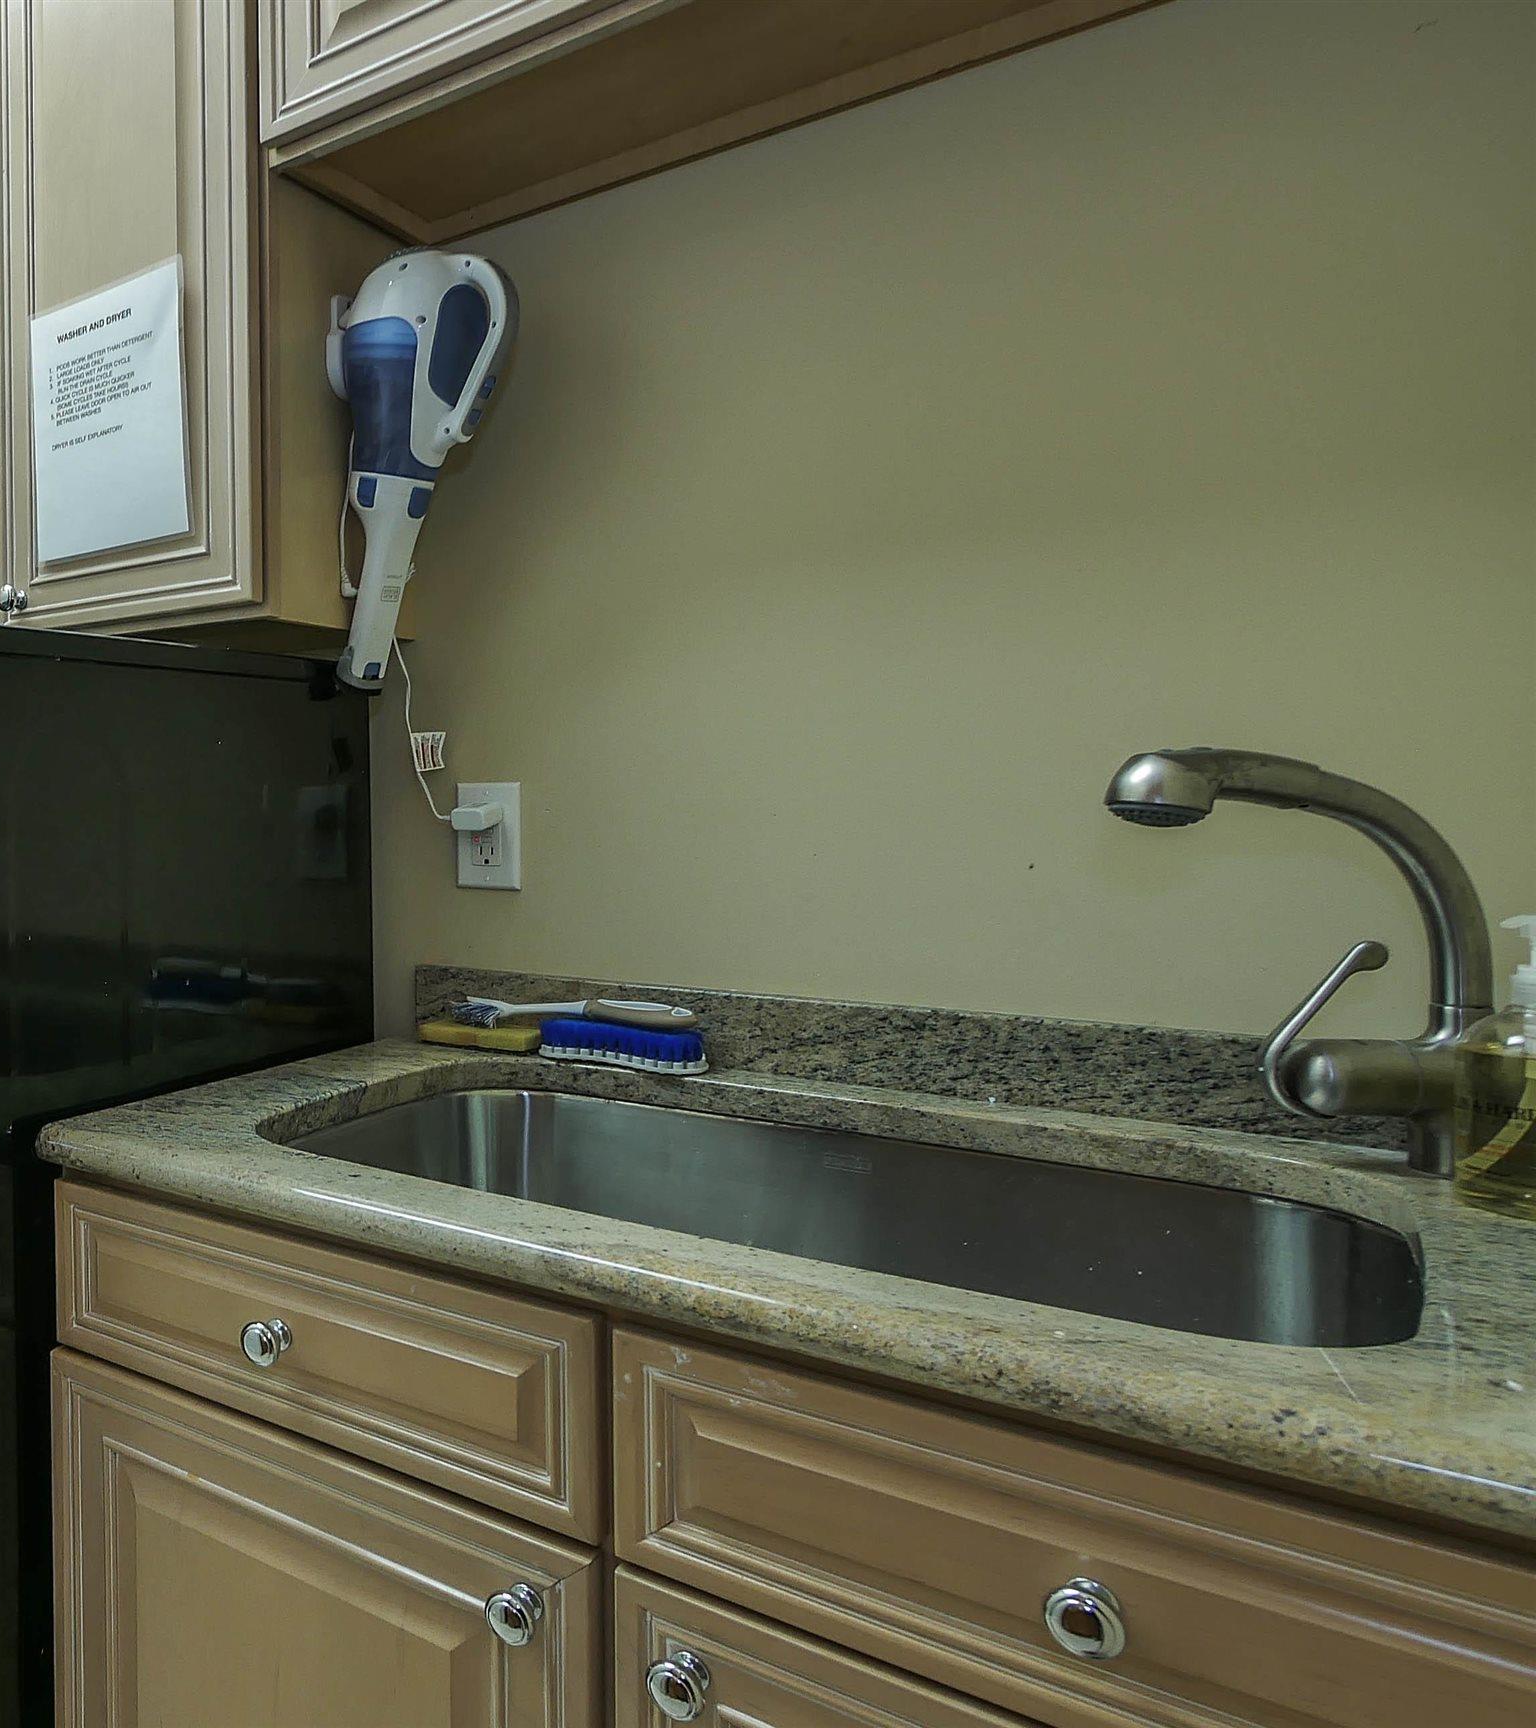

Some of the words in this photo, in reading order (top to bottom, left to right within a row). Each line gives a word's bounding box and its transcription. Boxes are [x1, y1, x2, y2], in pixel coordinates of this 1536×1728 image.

[57, 326, 88, 344] WASHER
[89, 319, 105, 331] AND
[106, 308, 132, 325] DRYER
[71, 355, 86, 366] WORK
[87, 348, 106, 360] BETTER
[107, 343, 120, 353] THAN
[122, 331, 153, 348] DETERGENT
[57, 369, 73, 379] LARGE
[74, 362, 90, 374] LOADS
[91, 357, 105, 368] ONLY
[63, 372, 85, 385] SOAKING
[85, 369, 96, 378] WET
[97, 363, 113, 374] AFTER
[114, 356, 131, 368] CYCLE
[80, 377, 95, 388] DRAIN
[96, 370, 113, 382] CYCLE
[55, 393, 71, 404] QUICK
[72, 386, 88, 398] CYCLE
[95, 380, 110, 391] MUCH
[111, 371, 134, 384] QUICKER
[56, 407, 74, 418] PLEASE
[75, 402, 90, 413] LEAVE
[91, 397, 106, 407] DOOR
[107, 392, 122, 402] OPEN
[122, 390, 130, 398] TO
[131, 386, 140, 394] AIR
[140, 382, 152, 391] OUT
[73, 394, 93, 406] CYCLES
[94, 389, 106, 399] TAKE
[56, 415, 80, 427] BETWEEN
[81, 407, 101, 419] WASHES
[51, 440, 68, 451] DRYER
[75, 434, 86, 444] SELF
[87, 424, 124, 441] EXPLANATORY
